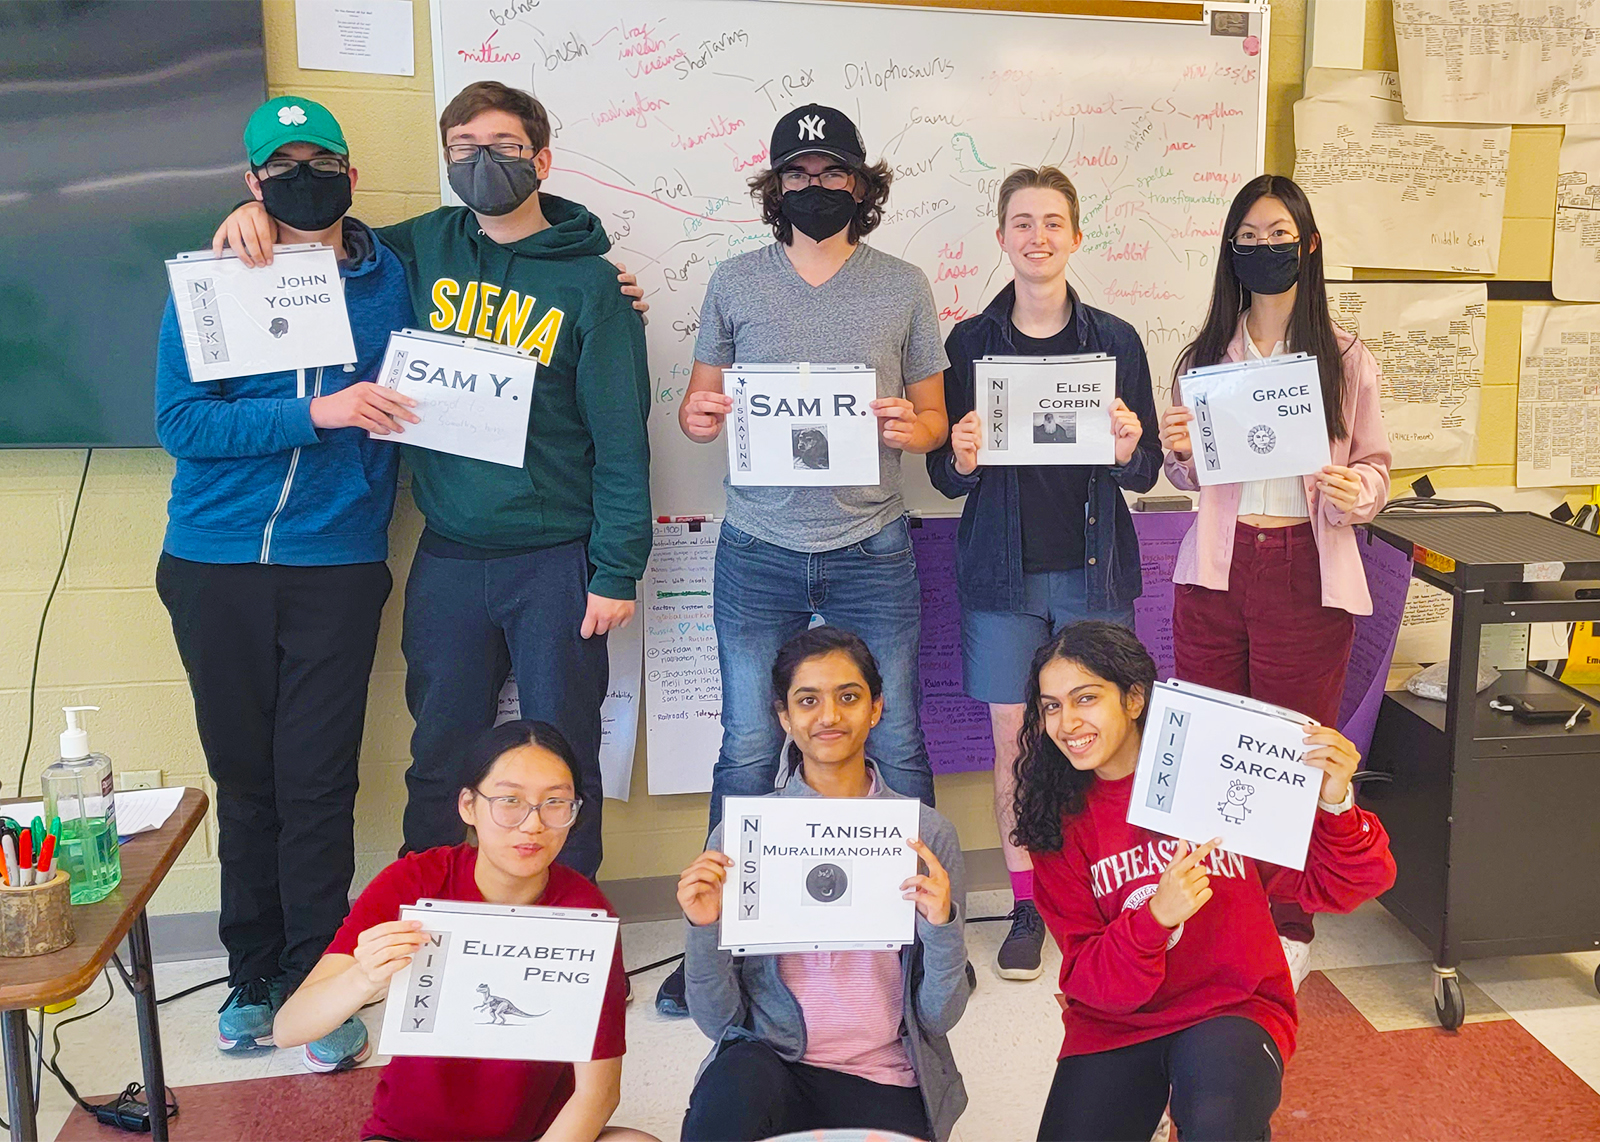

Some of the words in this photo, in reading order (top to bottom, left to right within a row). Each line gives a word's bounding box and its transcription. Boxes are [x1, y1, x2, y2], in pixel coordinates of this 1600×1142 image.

[458, 42, 522, 64] mittens
[844, 57, 955, 91] Dilophosaurus
[1378, 72, 1397, 86] The
[1041, 92, 1124, 122] internet
[1151, 98, 1176, 115] CS
[1192, 102, 1244, 131] python
[895, 146, 944, 182] saur
[1068, 146, 1118, 168] trolls
[1136, 166, 1175, 188] spells
[1080, 193, 1098, 202] on
[1083, 224, 1103, 241] red
[1431, 231, 1460, 246] Middle
[1467, 232, 1486, 247] East
[194, 281, 220, 360] NISKY
[429, 278, 565, 367] SIENA
[405, 359, 479, 393] SAM
[489, 372, 519, 401] Y.
[1056, 382, 1101, 393] ELISE
[1038, 398, 1101, 409] CORBIN
[1252, 385, 1310, 402] GRACE
[750, 394, 822, 418] SAM
[833, 394, 867, 417] R.
[992, 380, 1003, 448] NISKY
[1277, 403, 1312, 417] SUN
[735, 388, 749, 469] NISKAYUNA
[1195, 395, 1216, 468] NISKY
[696, 622, 715, 632] Wes
[661, 668, 721, 678] Industrializa
[1154, 711, 1185, 807] NISKY
[1219, 754, 1307, 788] SARCAR
[805, 823, 903, 839] TANISHA
[762, 845, 903, 857] MURALIMANOHAR
[743, 818, 759, 917] NISKY
[462, 939, 596, 962] ELIZABETH
[412, 933, 443, 1030] NISKY
[523, 966, 591, 984] PENG
